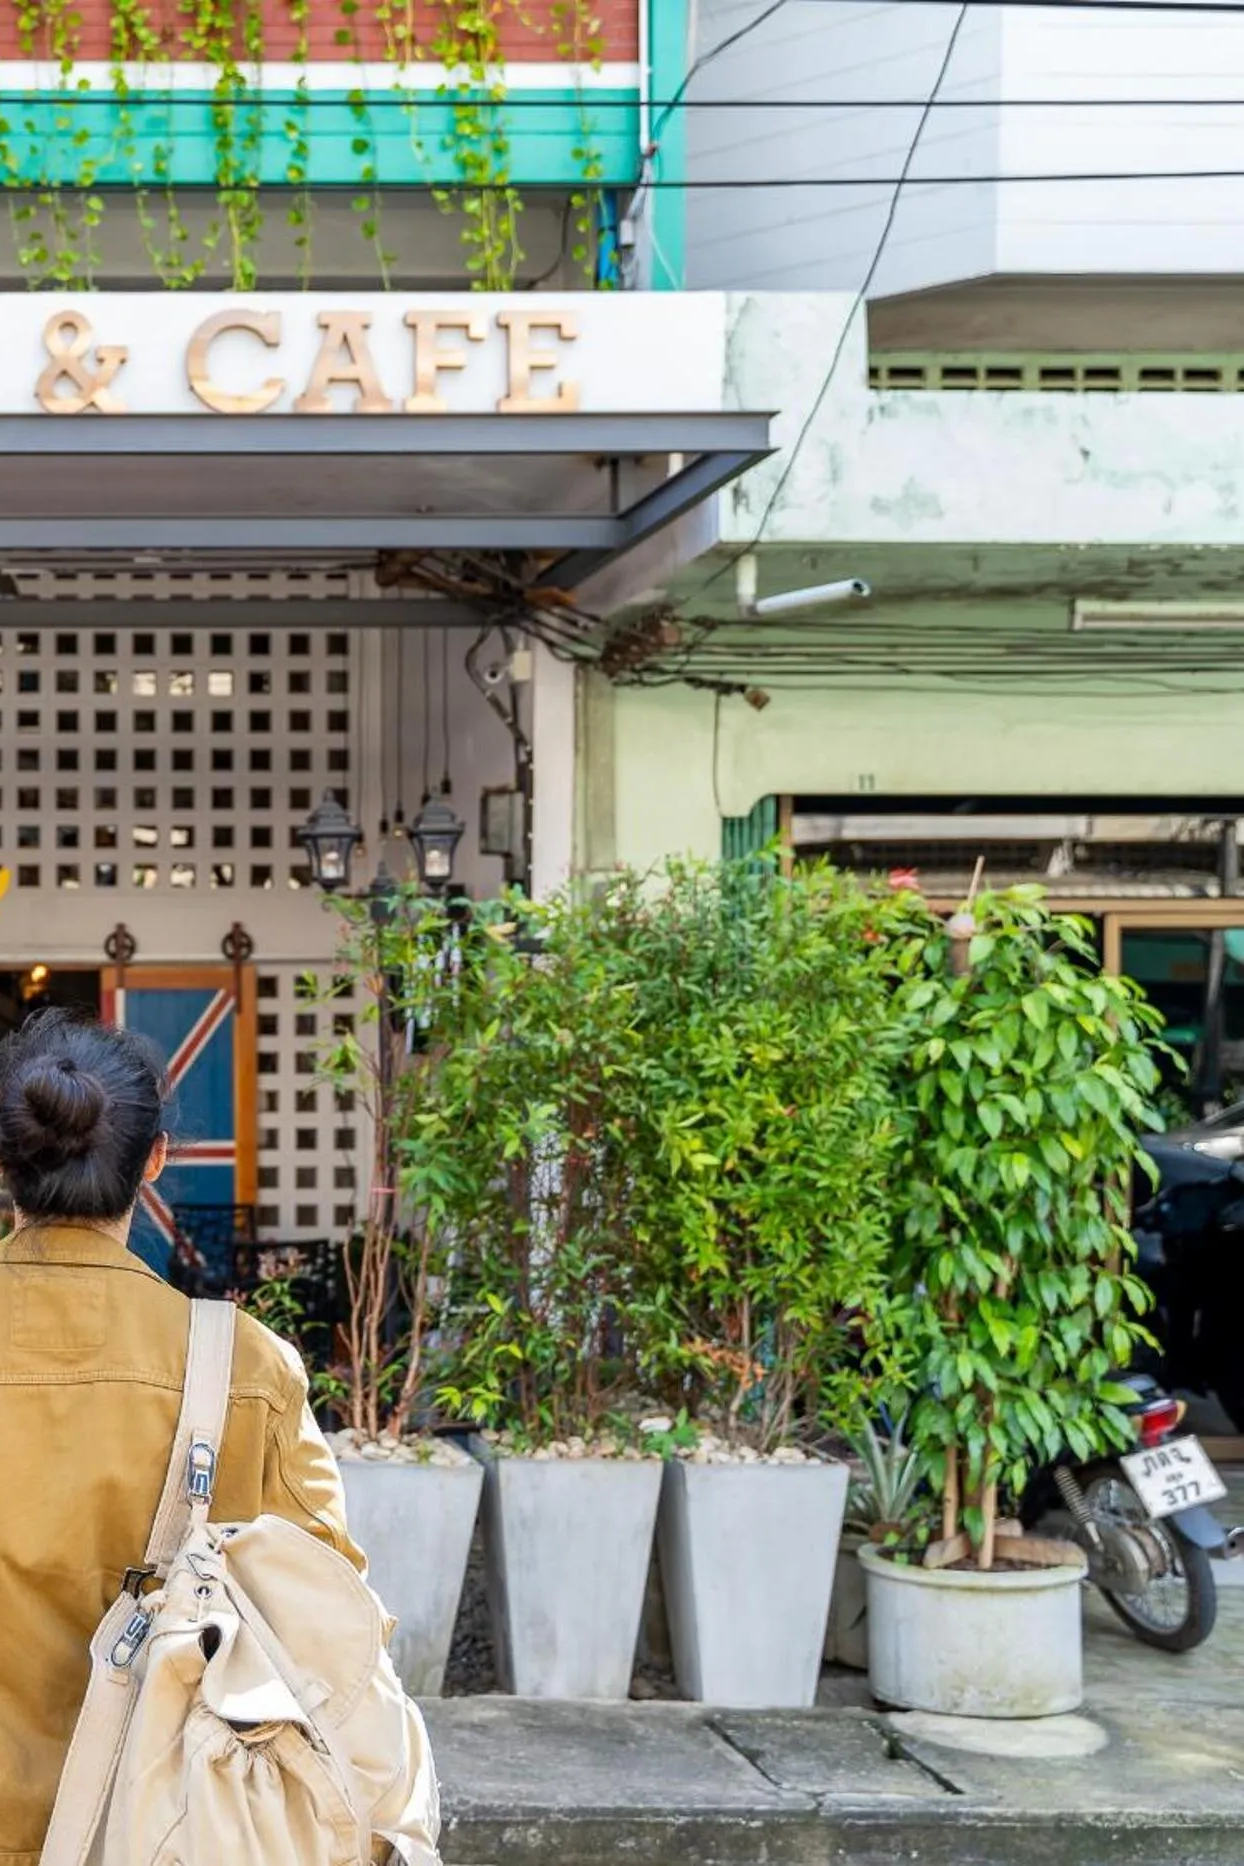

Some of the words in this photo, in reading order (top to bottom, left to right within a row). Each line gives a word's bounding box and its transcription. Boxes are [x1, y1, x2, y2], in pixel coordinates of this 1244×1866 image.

[34, 309, 129, 414] &
[185, 309, 581, 414] CAFE
[1161, 1480, 1201, 1506] 377
